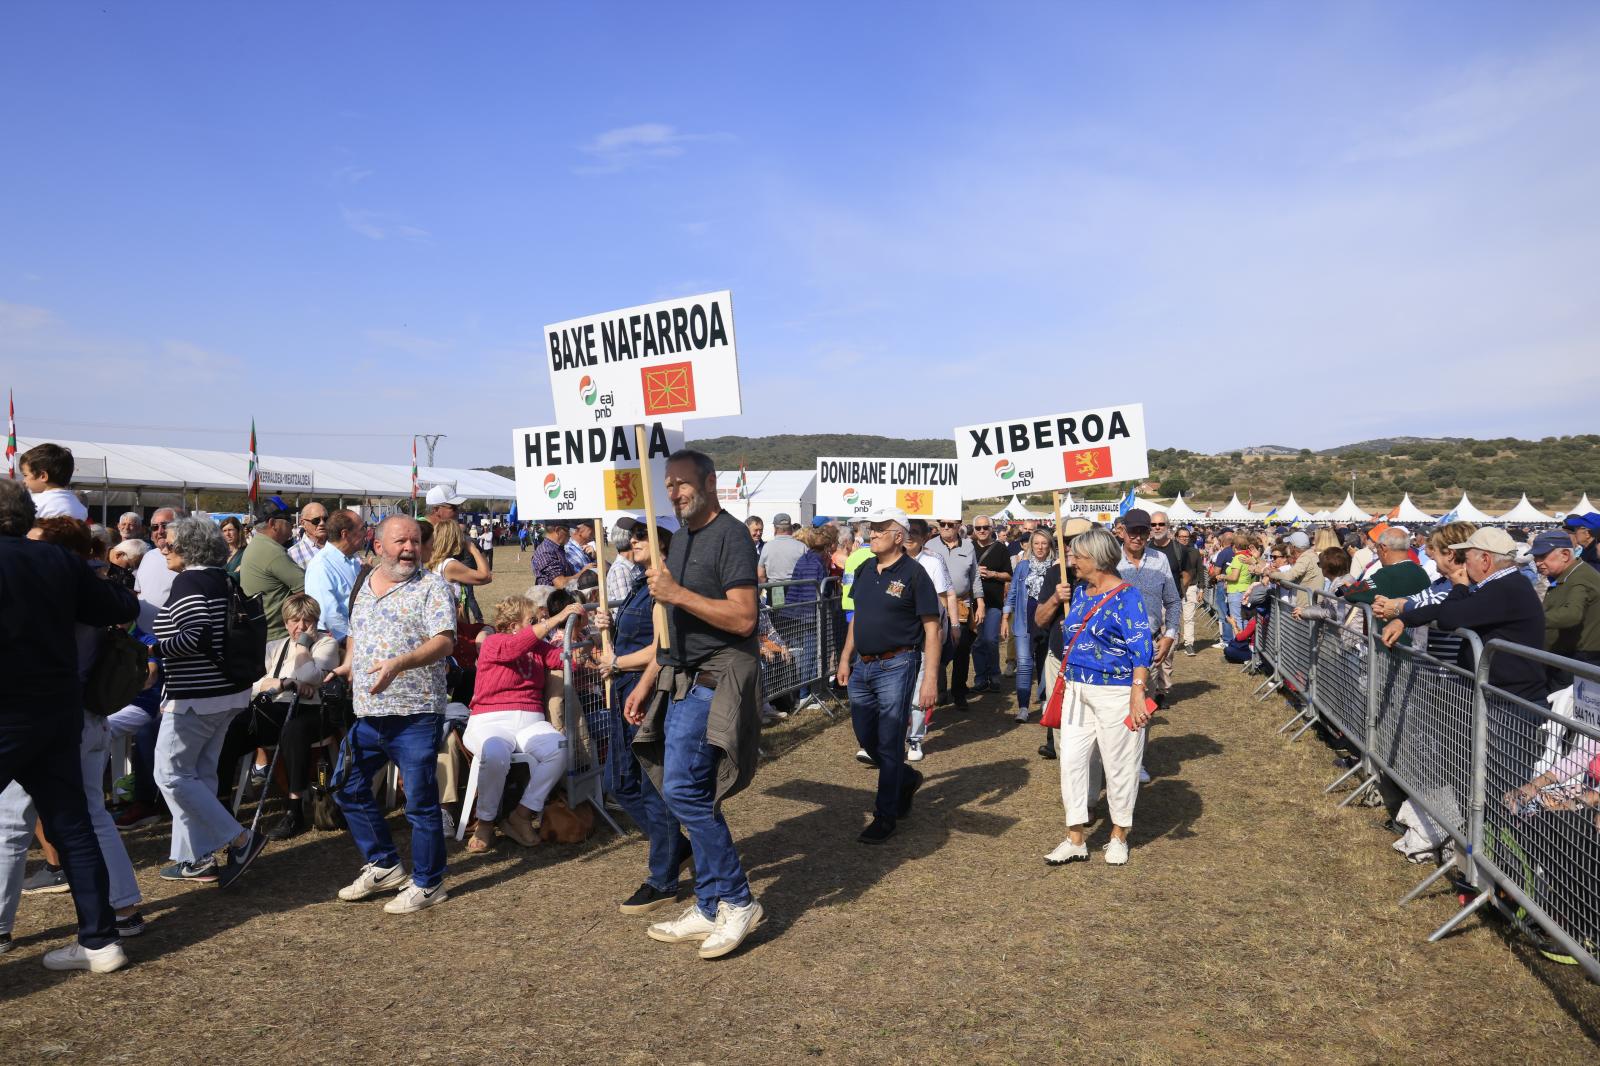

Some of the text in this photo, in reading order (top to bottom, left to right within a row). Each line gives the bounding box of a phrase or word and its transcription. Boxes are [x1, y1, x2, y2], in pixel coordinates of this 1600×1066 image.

[549, 301, 729, 371] BAXE NAFARROA
[595, 405, 611, 421] pnb
[969, 410, 1130, 457] XIBEROA
[821, 461, 958, 486] DONIBANE LOHITZUN
[1011, 478, 1031, 490] pnb
[557, 500, 574, 512] pnb
[854, 506, 869, 514] pnb
[1070, 504, 1119, 512] LAPURDI BARNEKALDE
